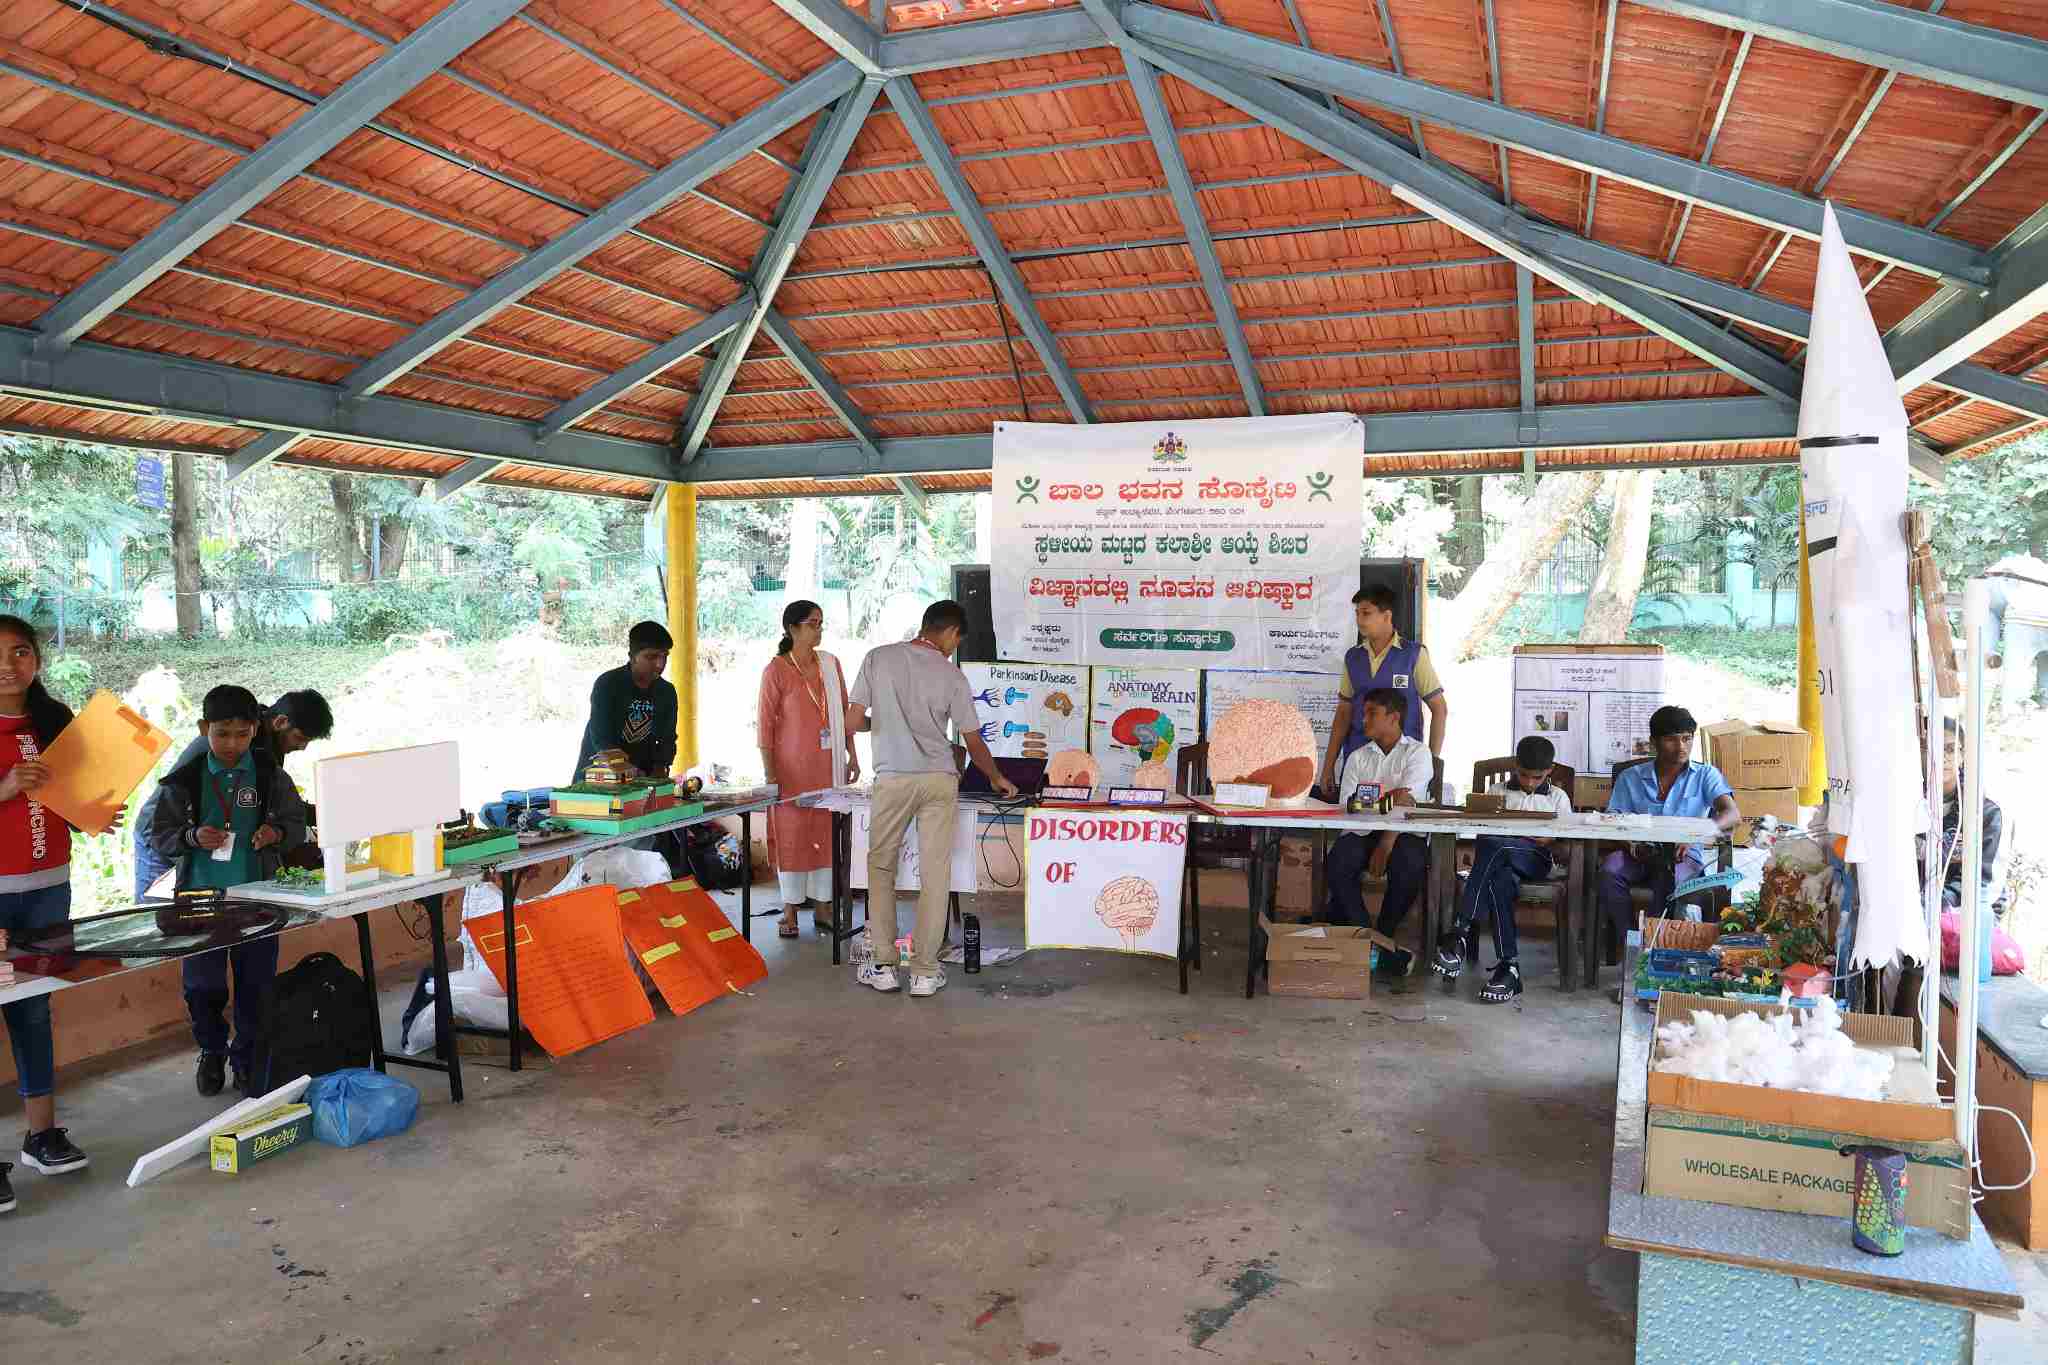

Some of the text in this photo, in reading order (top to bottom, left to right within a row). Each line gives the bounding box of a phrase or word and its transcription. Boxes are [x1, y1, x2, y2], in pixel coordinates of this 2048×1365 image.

[1048, 476, 1297, 509] ಬಾಲ ಭವನ ಸೊಸೈಟಿ
[1034, 530, 1309, 566] ಸ್ಥಳೀಯ ಮಟ್ಟದ ಕಲಾಶ್ರೀ ಆಯ್ಕೆ ಶಿಬಿರ
[1028, 573, 1129, 609] ವಿಜ್ಞಾನದಲ್ಲಿ
[1139, 574, 1217, 599] ನೂತನ
[1107, 681, 1172, 693] ANATOMY
[1151, 690, 1196, 704] BRAIN
[1029, 816, 1187, 846] DISORDERS
[1045, 861, 1078, 883] OF
[1685, 1159, 1854, 1195] WHOLESALE PACKAGE
